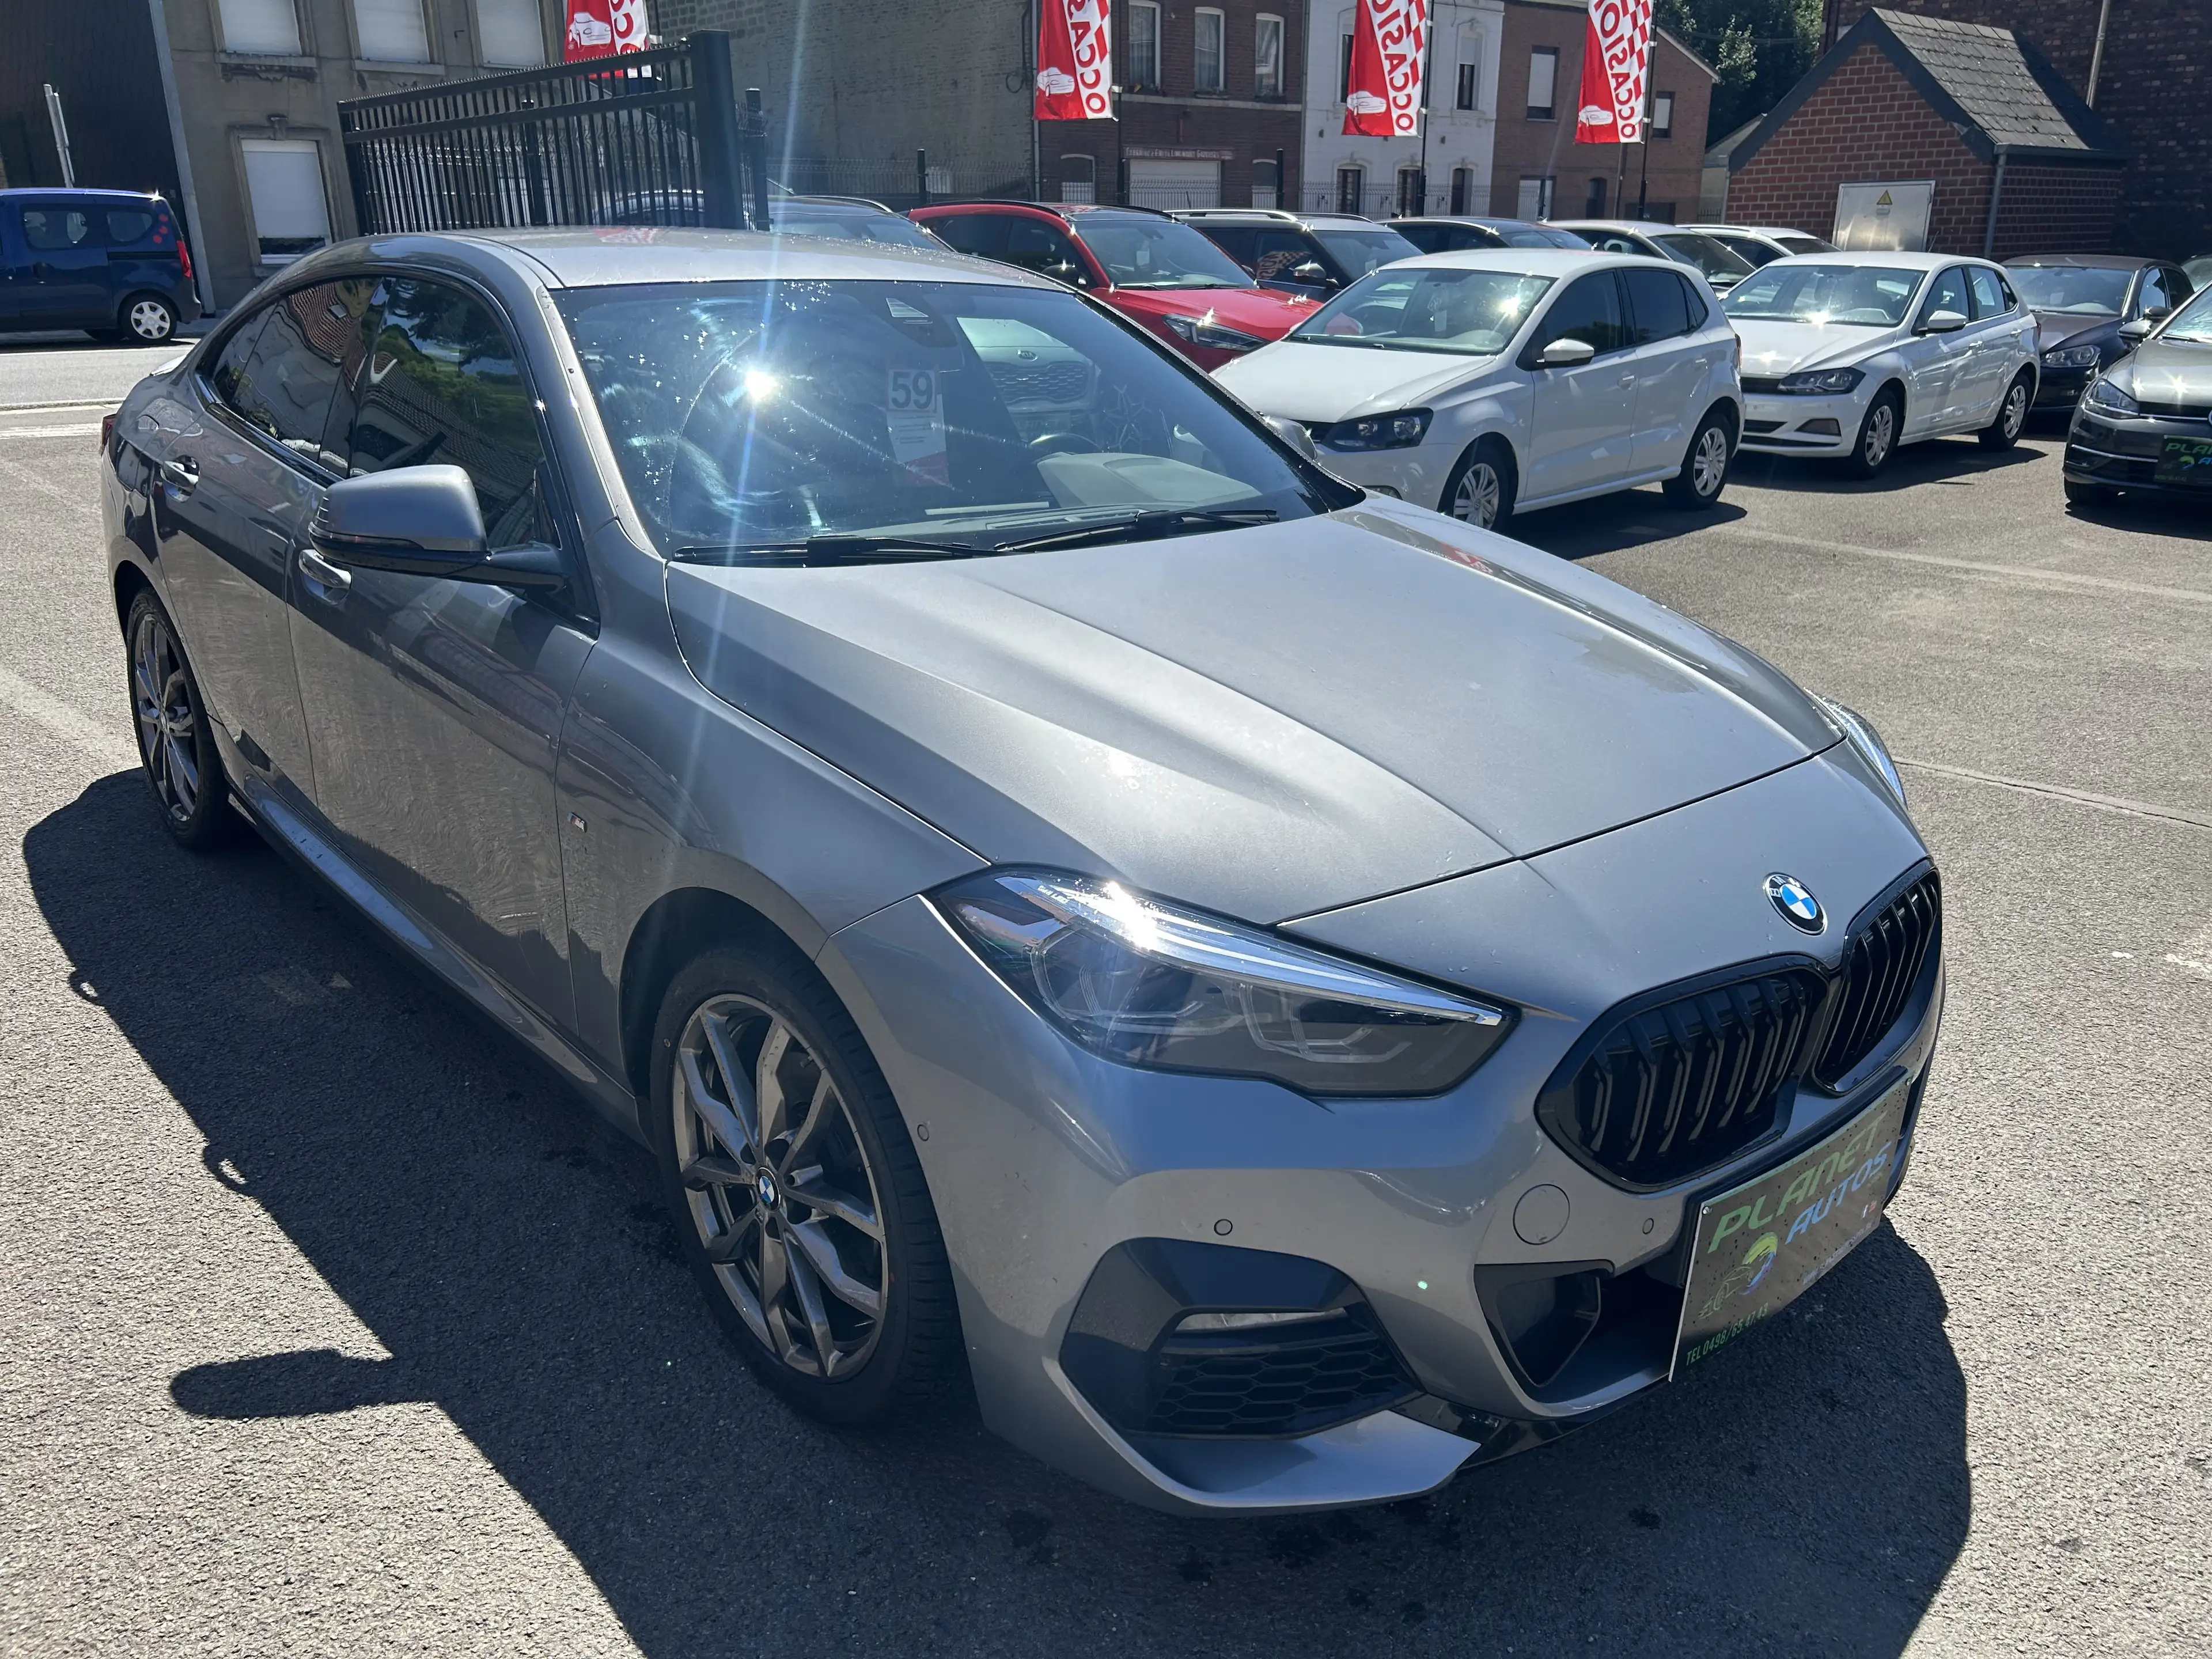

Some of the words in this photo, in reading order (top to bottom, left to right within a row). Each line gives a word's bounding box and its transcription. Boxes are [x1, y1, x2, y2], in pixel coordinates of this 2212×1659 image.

[891, 372, 933, 410] 59
[1707, 1110, 1888, 1253] PLANET
[1785, 1141, 1891, 1245] AUTOS
[1685, 1346, 1701, 1366] TEL
